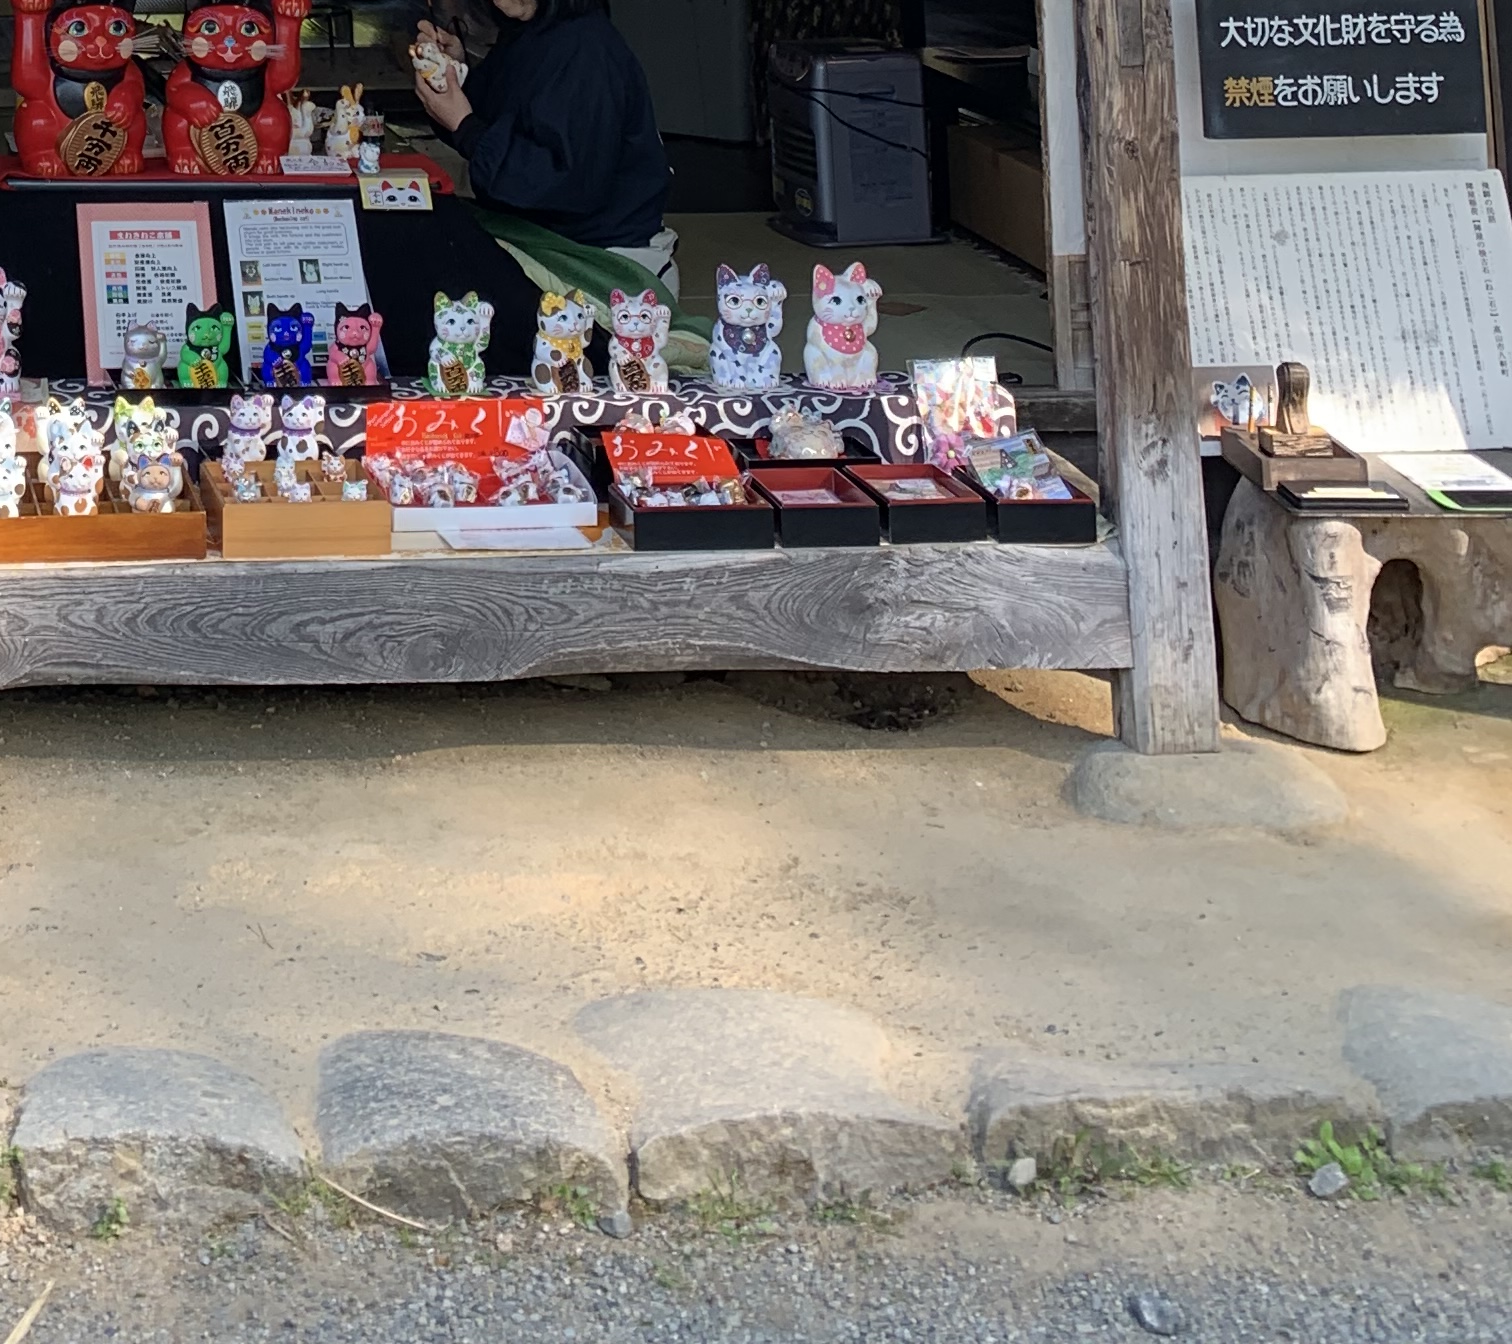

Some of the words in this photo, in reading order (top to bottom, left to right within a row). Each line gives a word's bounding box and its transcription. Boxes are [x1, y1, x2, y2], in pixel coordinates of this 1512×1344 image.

[1220, 12, 1465, 49] 大切な文化財を守る為
[90, 82, 105, 110] 飛騨
[222, 83, 238, 110] 飛騨
[1224, 73, 1444, 107] 禁煙をお願いします
[74, 120, 118, 175] 千万両
[208, 118, 250, 175] 百万両
[393, 400, 513, 438] おみくじ
[612, 435, 722, 461] おみくじ
